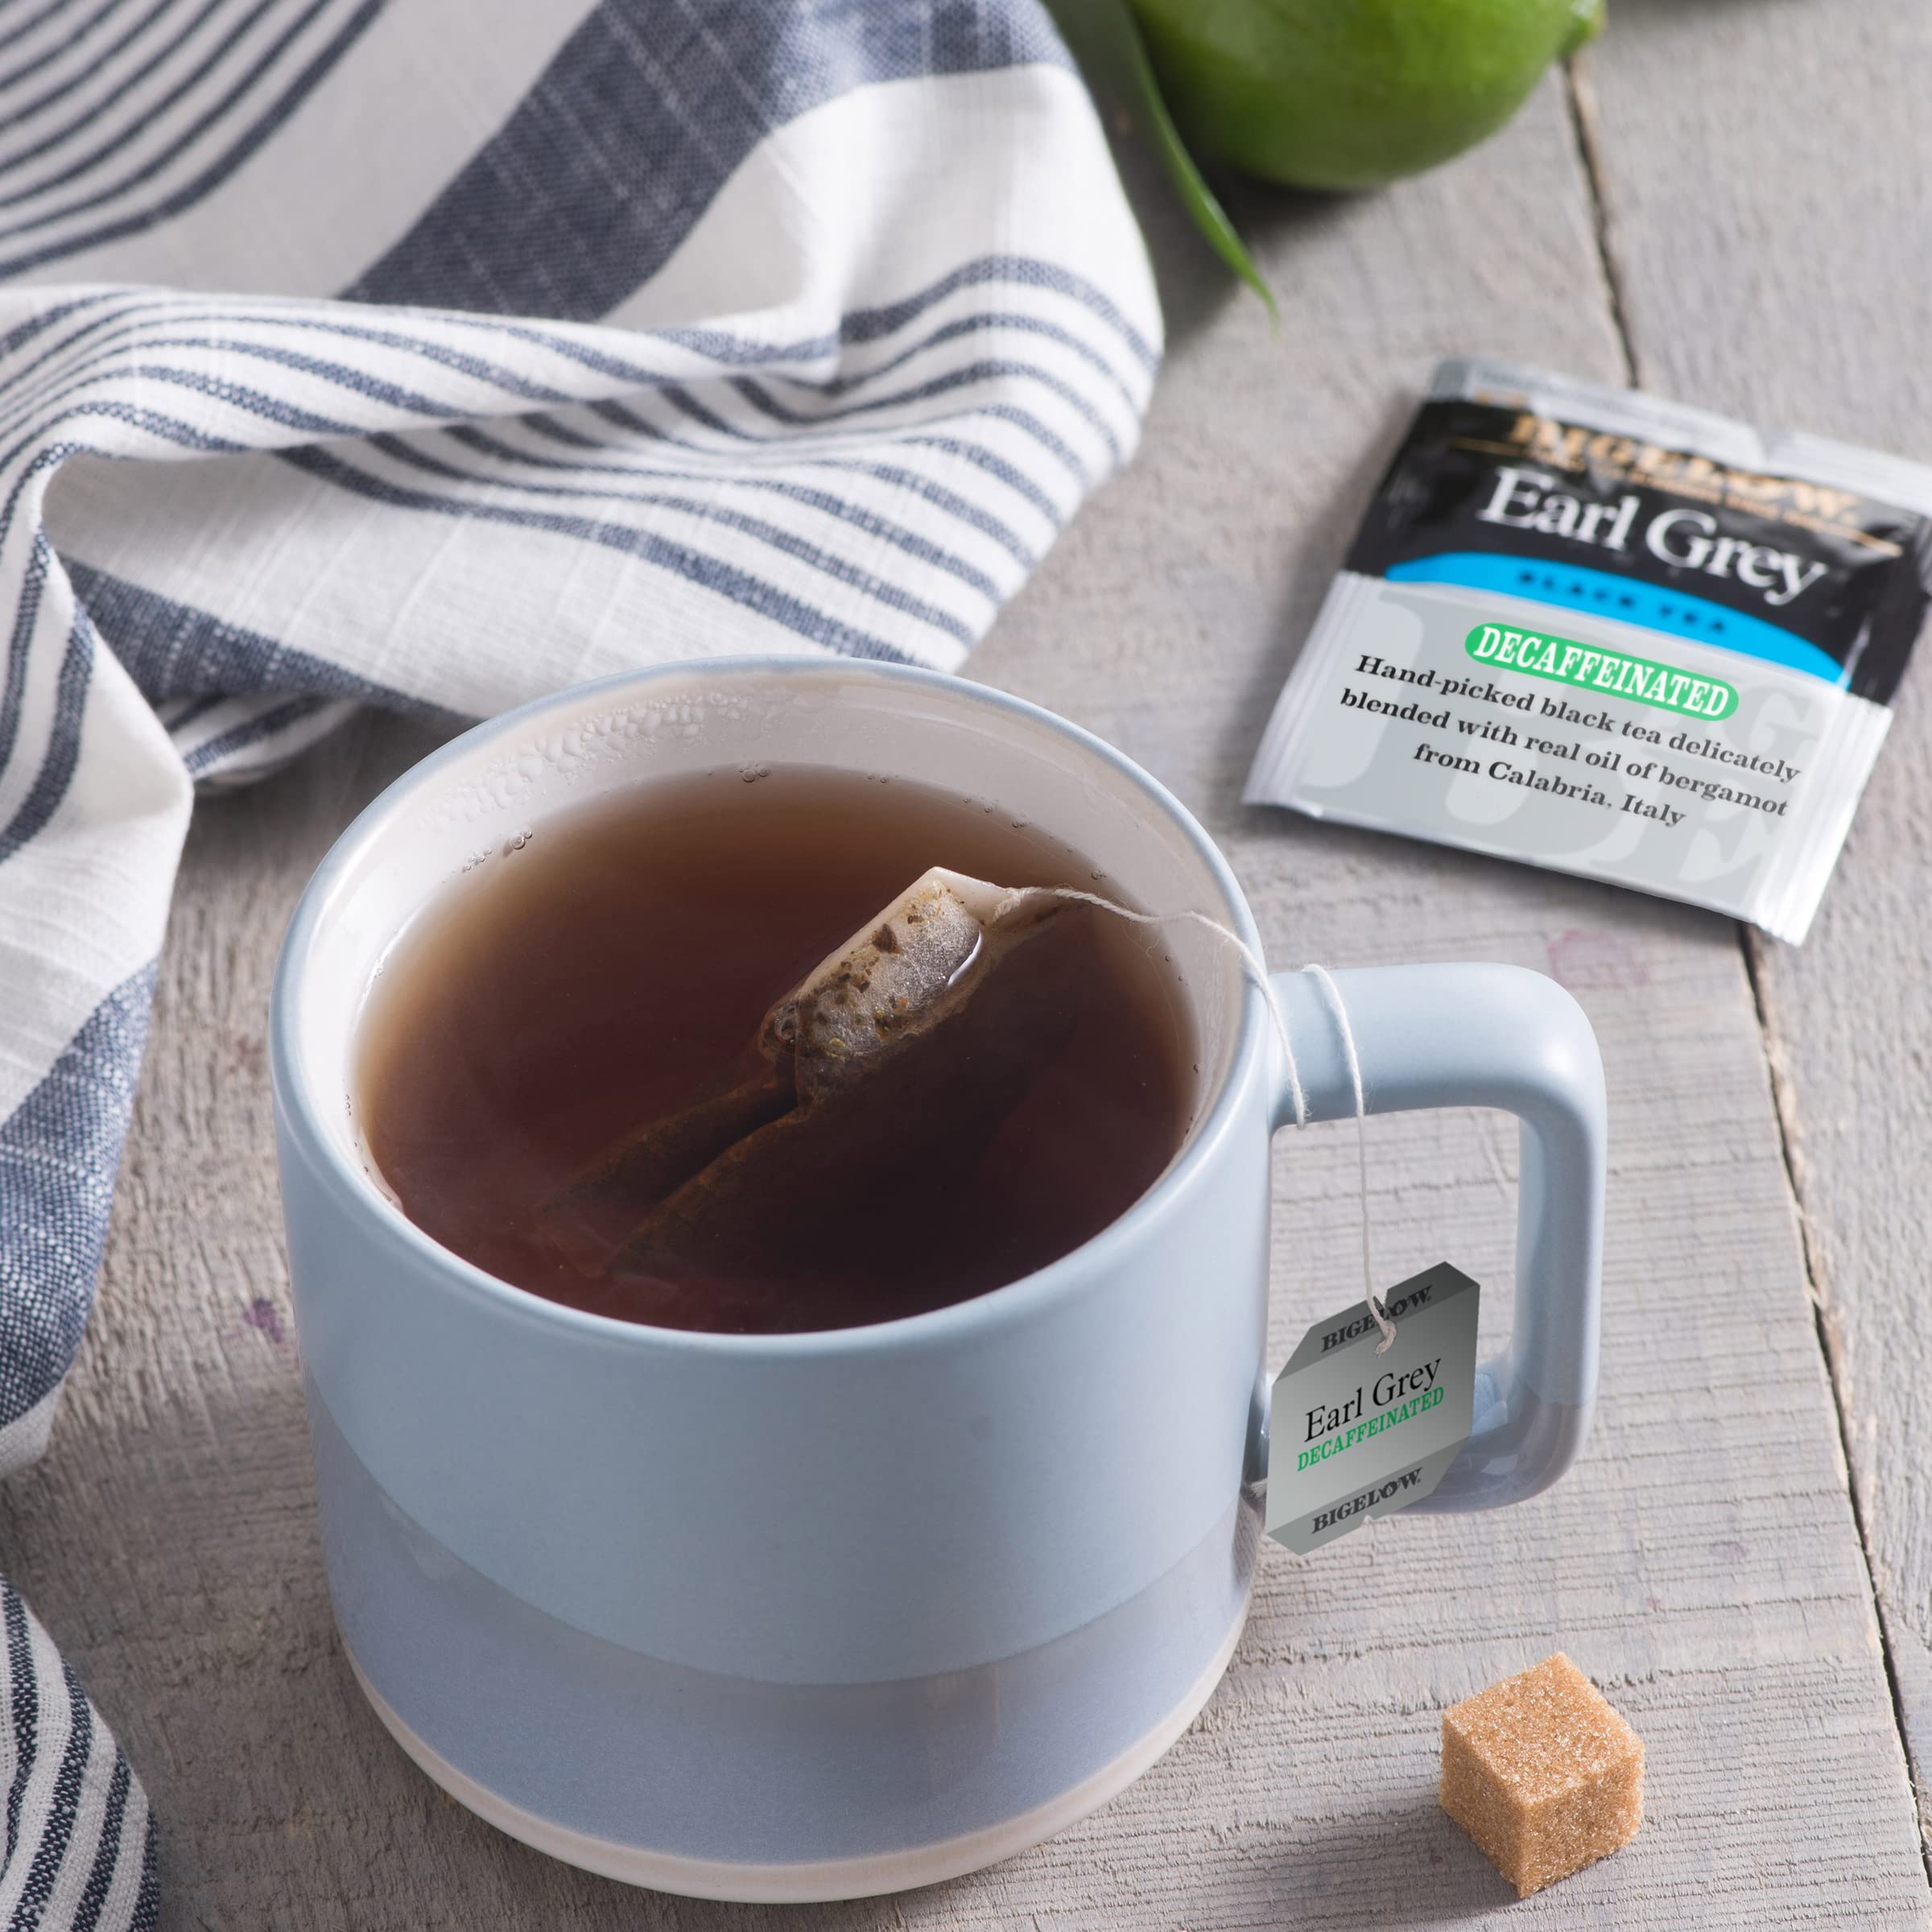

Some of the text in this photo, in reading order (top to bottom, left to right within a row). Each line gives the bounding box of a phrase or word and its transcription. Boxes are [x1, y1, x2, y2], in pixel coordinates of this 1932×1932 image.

[1476, 466, 1640, 551] Earl
[1646, 509, 1827, 605] Grey
[1473, 627, 1730, 716] DECAFFEINATED
[1340, 688, 1789, 816] blended with real oil of bergamot
[1355, 654, 1802, 783] Hand-picked black tea delicately
[1413, 743, 1480, 774] from
[1620, 794, 1686, 827] Italy
[1297, 1386, 1445, 1472] DECAFFEINATED
[1304, 1358, 1441, 1443] Earl Grey
